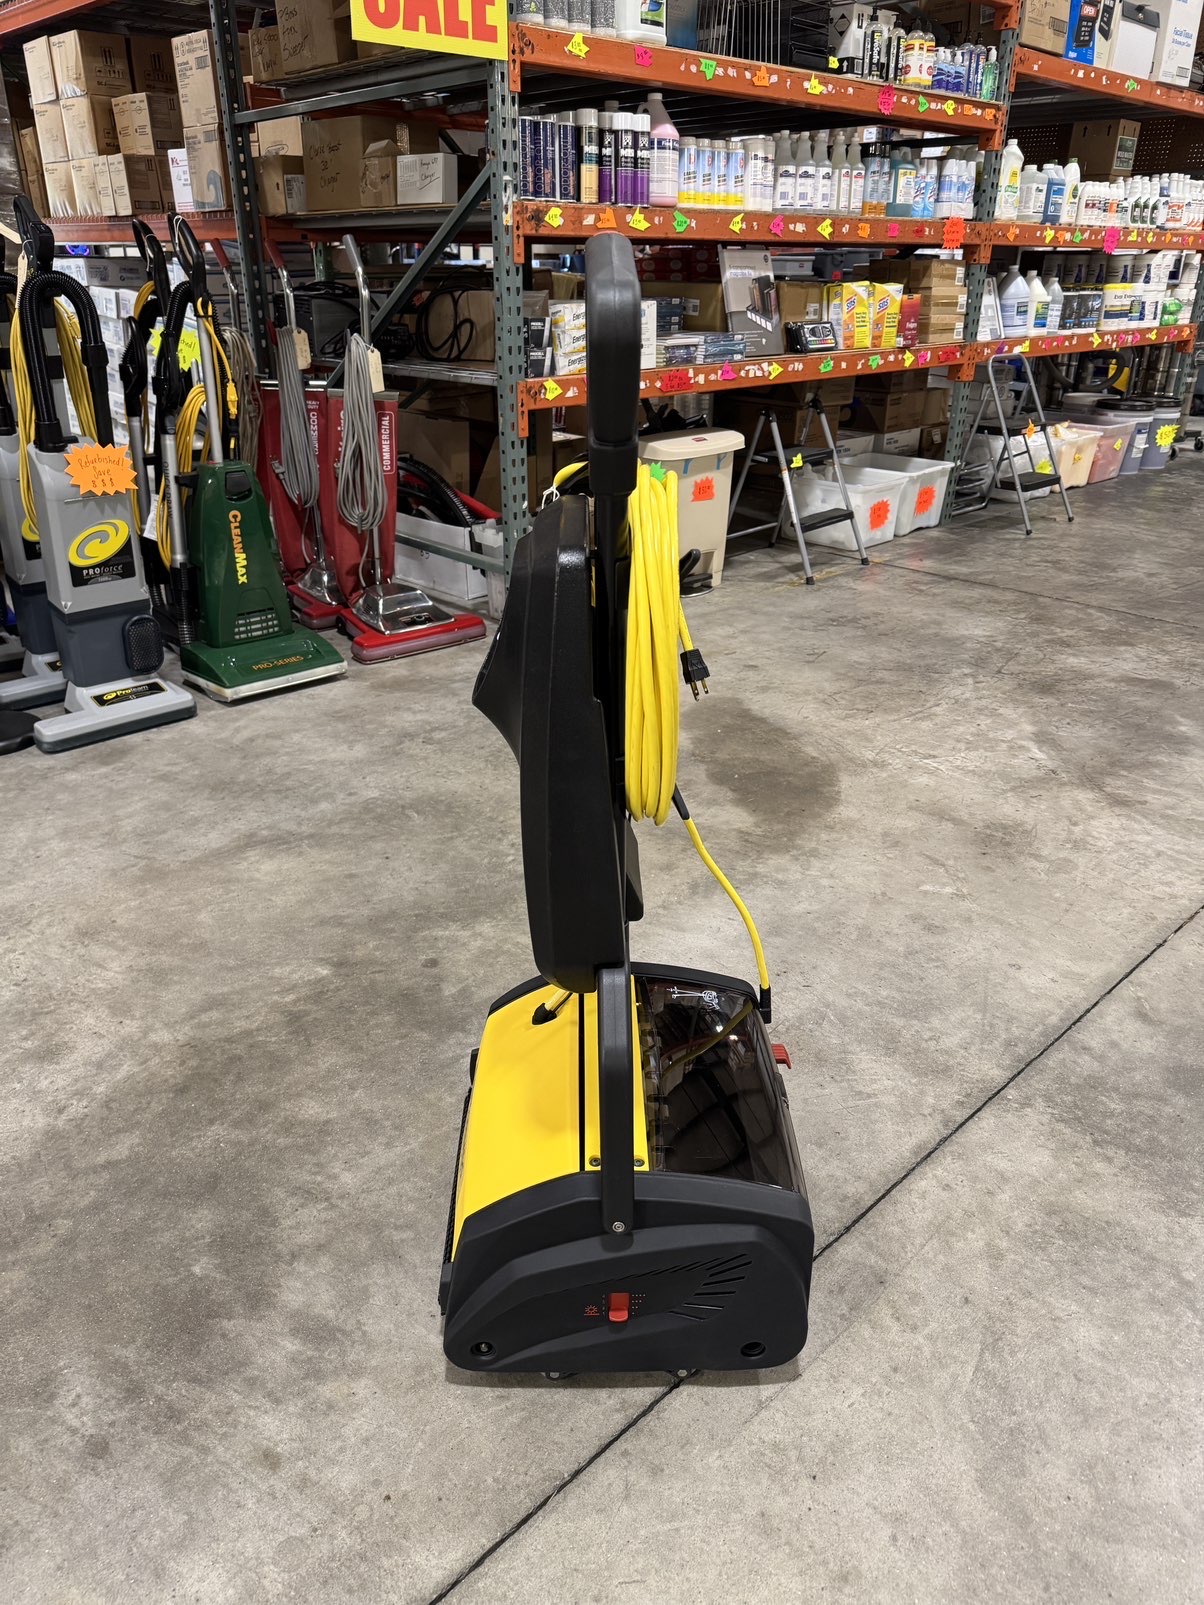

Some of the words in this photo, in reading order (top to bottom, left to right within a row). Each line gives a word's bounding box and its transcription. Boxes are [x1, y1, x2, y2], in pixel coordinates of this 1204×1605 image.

[382, 415, 390, 471] COMMERCIAL
[77, 453, 125, 470] Refurbished!
[92, 467, 112, 480] Save
[82, 564, 123, 577] PROforce
[252, 655, 304, 671] PRO-SERIES
